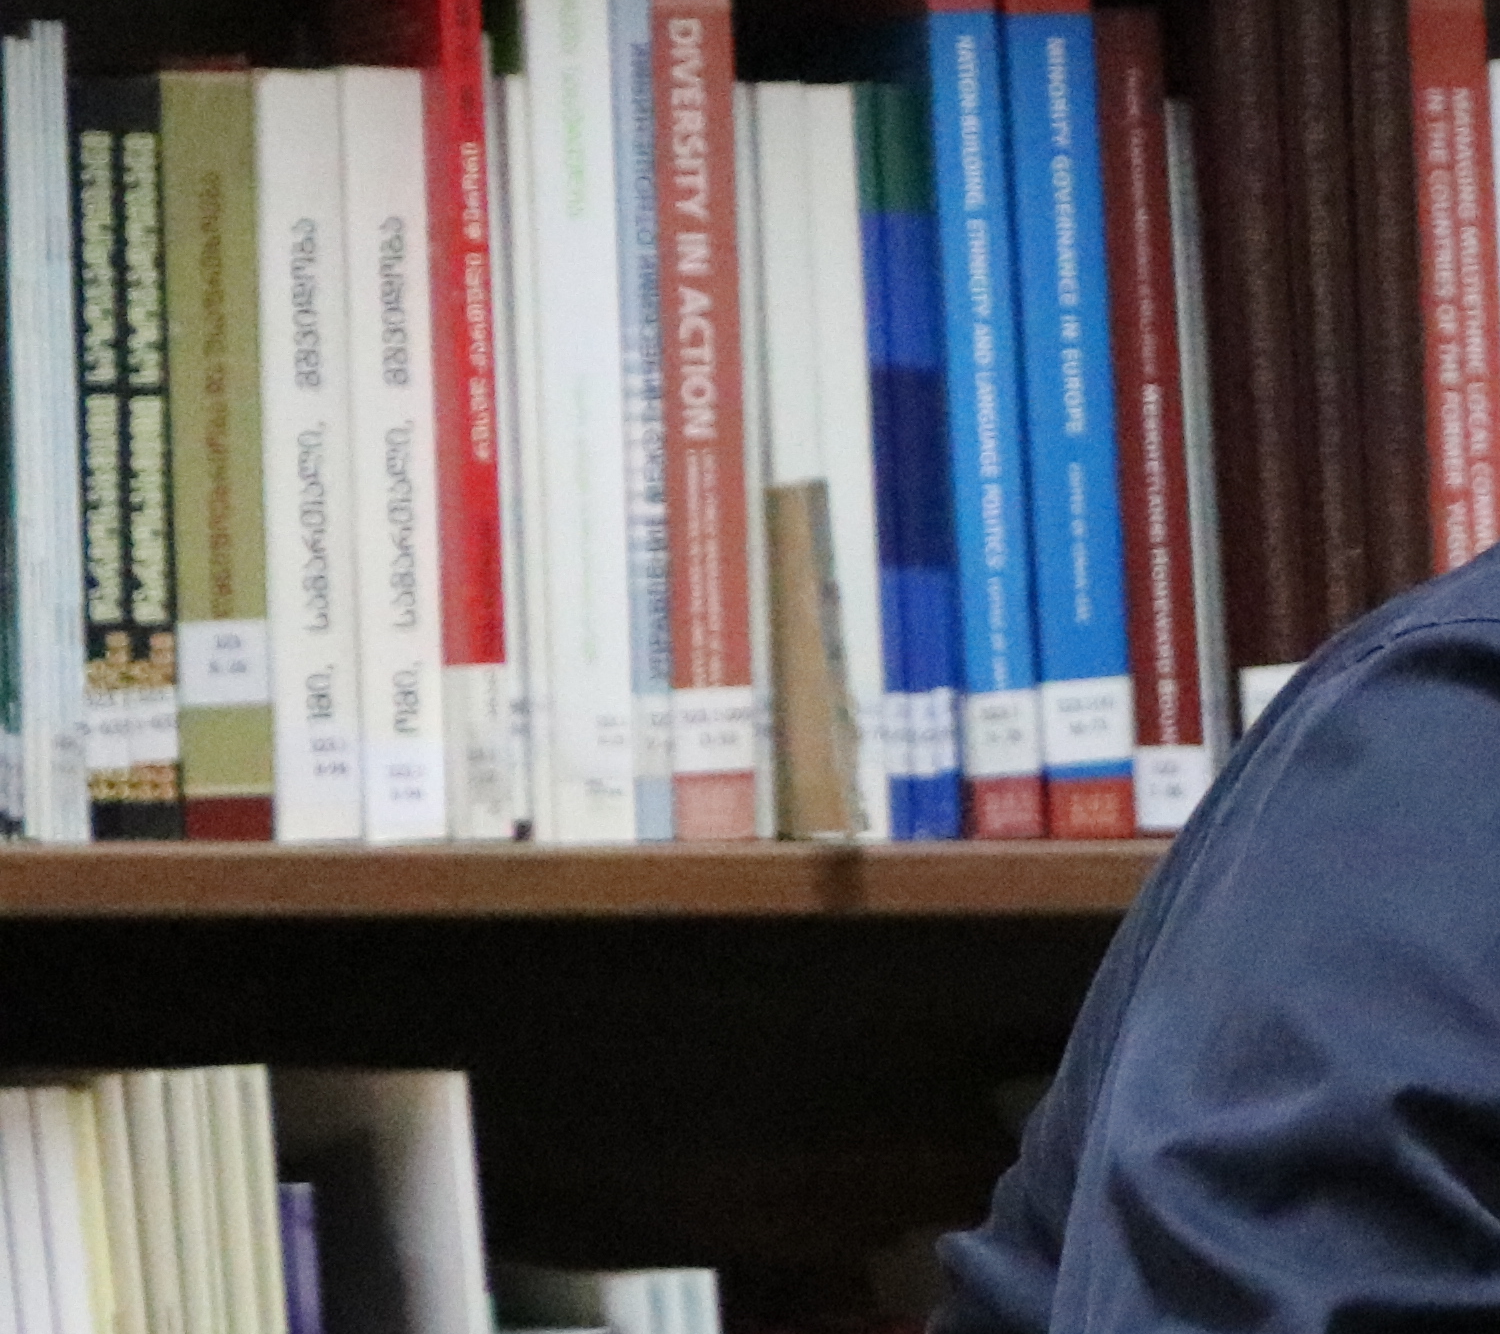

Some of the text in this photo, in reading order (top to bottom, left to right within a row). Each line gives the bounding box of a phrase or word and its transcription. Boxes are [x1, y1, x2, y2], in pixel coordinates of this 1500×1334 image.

[663, 16, 710, 218] DIVERSITY
[1044, 37, 1071, 146] MINORITY
[1424, 121, 1449, 162] THE
[1445, 86, 1478, 219] MANAGING
[674, 232, 711, 274] IN
[1050, 154, 1079, 306] GOVERNANCE
[1426, 169, 1455, 297] COUNTRIES
[288, 215, 322, 393] მშვიდობა
[376, 214, 408, 388] მშვიდობა
[970, 322, 995, 365] AND
[1058, 314, 1081, 341] IN
[1432, 304, 1456, 334] OF
[1453, 226, 1488, 374] MULTIETHNIC
[675, 287, 719, 439] ACTION
[1059, 348, 1086, 437] EUROPE
[1434, 343, 1459, 385] THE
[972, 371, 1000, 479] LANGUAGE
[1436, 390, 1463, 488] FORMER
[1463, 382, 1493, 455] LOCAL
[980, 483, 1005, 569] POLITICS
[1441, 502, 1467, 569] YUGO
